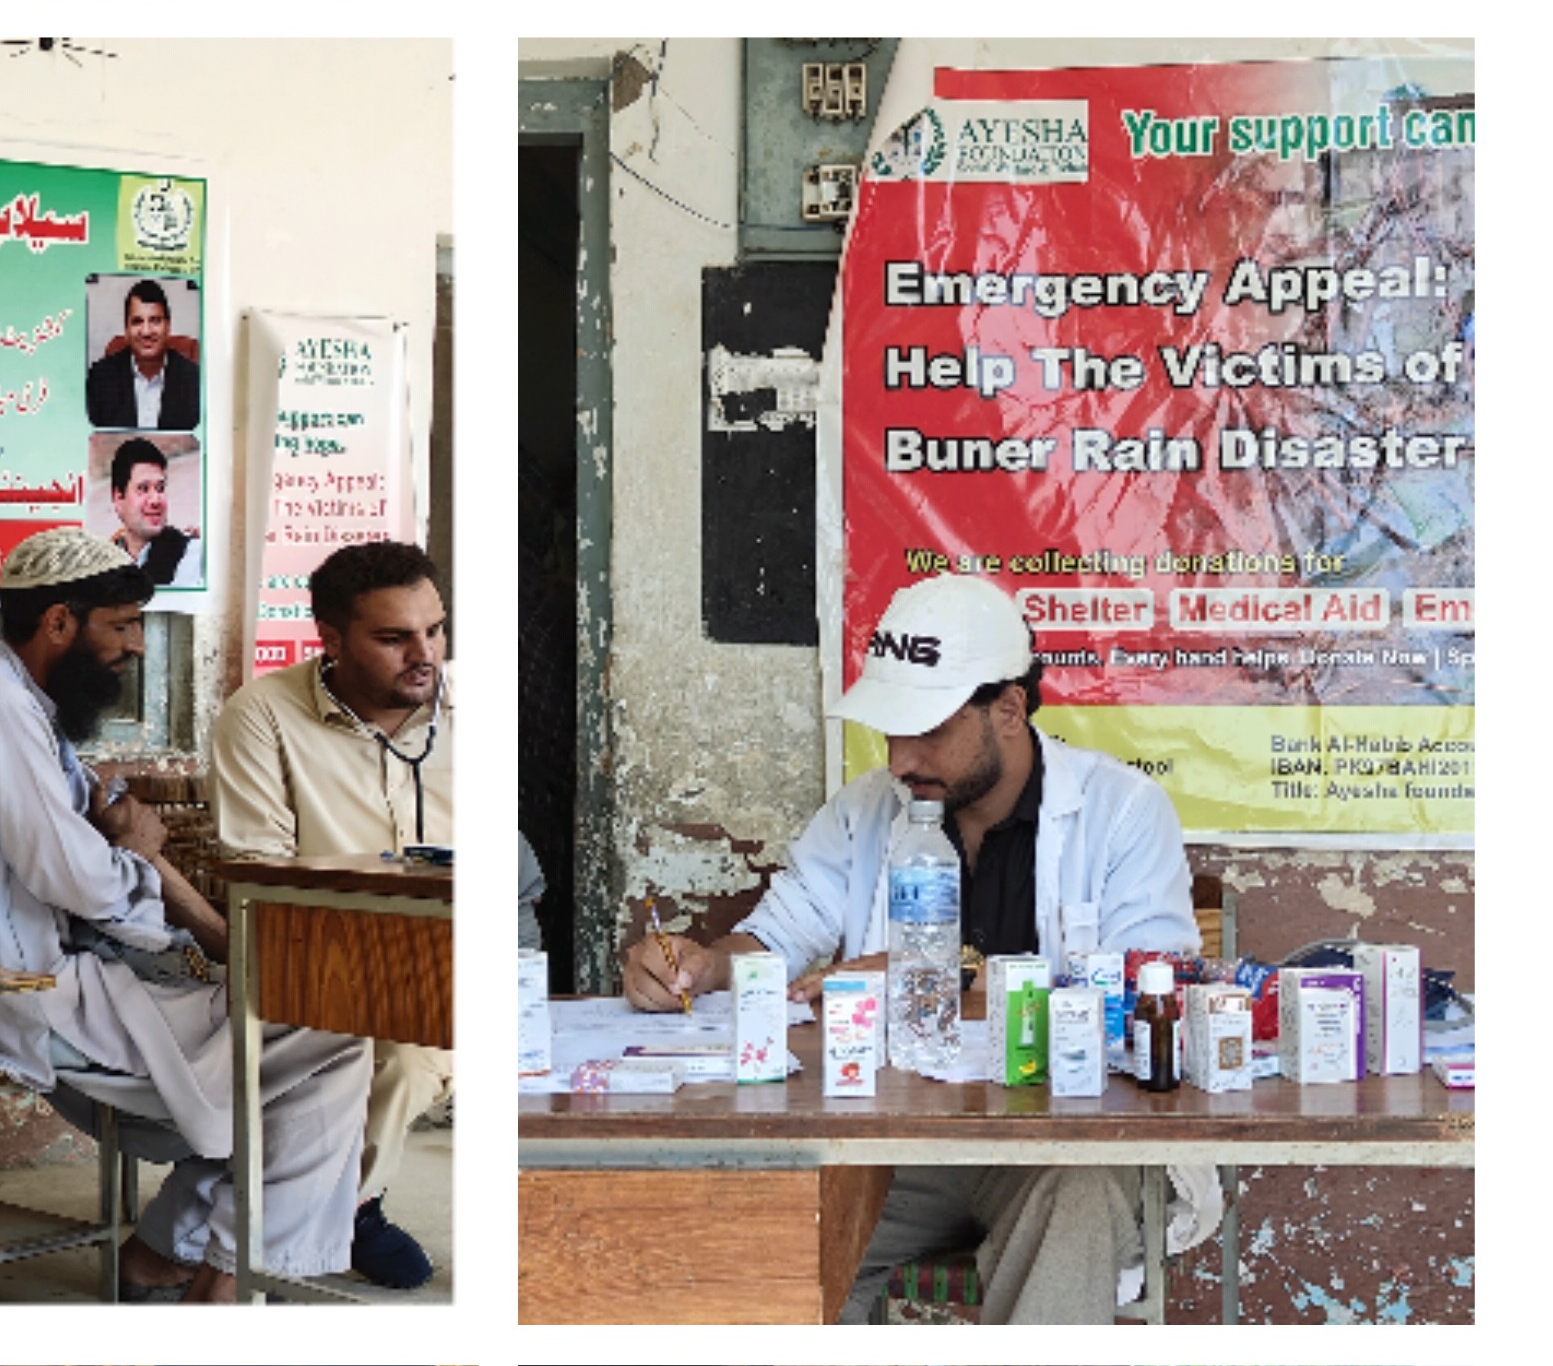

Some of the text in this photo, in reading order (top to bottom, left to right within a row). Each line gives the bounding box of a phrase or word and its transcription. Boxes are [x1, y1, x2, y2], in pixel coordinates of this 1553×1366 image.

[958, 118, 1088, 143] AYESHA
[1123, 106, 1475, 164] Your support can
[957, 144, 1087, 163] FOUNDATION
[883, 255, 1451, 316] Emergency Appeal:
[883, 340, 1465, 401] Help The Victims of
[883, 425, 1469, 474] Buner Rain Disaster
[904, 548, 1346, 578] We are collecting donations for
[1024, 594, 1149, 623] Shelter
[1177, 594, 1312, 624] Medical
[1322, 594, 1382, 623] Aid
[1109, 648, 1168, 671] Every
[1174, 648, 1226, 666] hand
[1300, 648, 1375, 667] Donate
[1271, 735, 1321, 753] Bank
